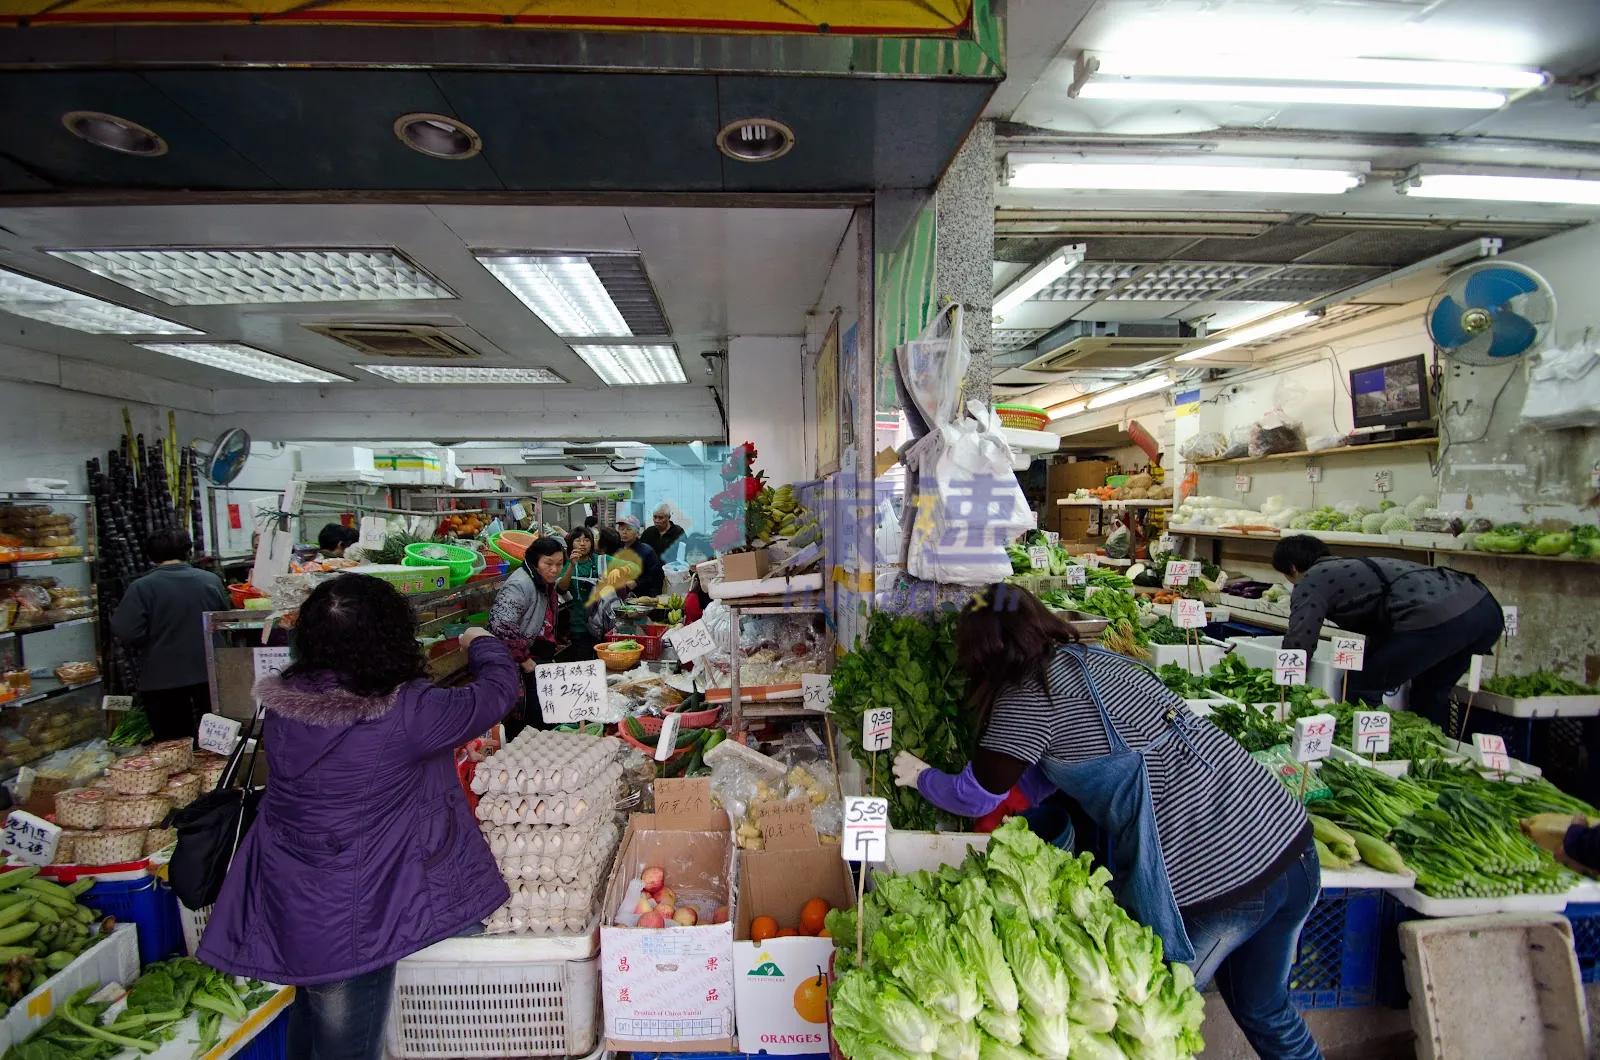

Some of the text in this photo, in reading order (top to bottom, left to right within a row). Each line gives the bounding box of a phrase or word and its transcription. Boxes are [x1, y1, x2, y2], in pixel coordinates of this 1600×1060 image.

[1169, 562, 1188, 573] 11元
[1337, 639, 1363, 652] 12元
[1278, 653, 1304, 667] 9元
[1334, 652, 1356, 669] 半斤
[1283, 670, 1299, 685] 斤
[871, 710, 892, 731] 9.50
[1360, 715, 1388, 732] 9.50
[1304, 723, 1333, 737] 5元
[874, 733, 889, 750] 斤
[1365, 735, 1385, 753] 斤
[847, 801, 887, 822] 5.50
[855, 830, 879, 861] 斤
[760, 1033, 822, 1044] ORANGES
